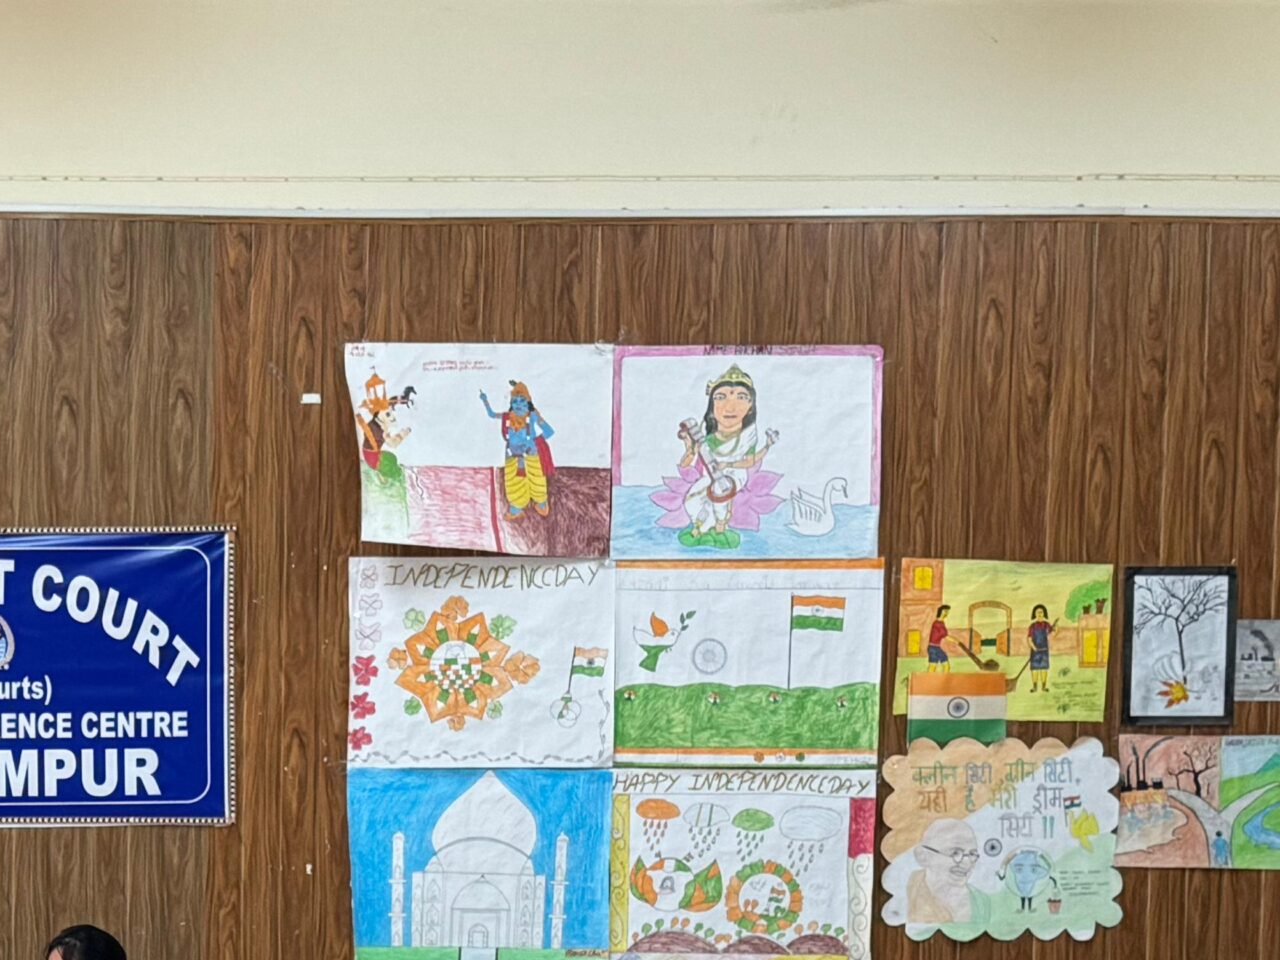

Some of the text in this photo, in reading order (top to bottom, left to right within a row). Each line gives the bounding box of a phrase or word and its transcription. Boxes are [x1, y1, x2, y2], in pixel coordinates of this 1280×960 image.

[32, 564, 200, 687] COURT
[81, 710, 189, 739] CENTRE
[612, 770, 680, 794] HAPPY
